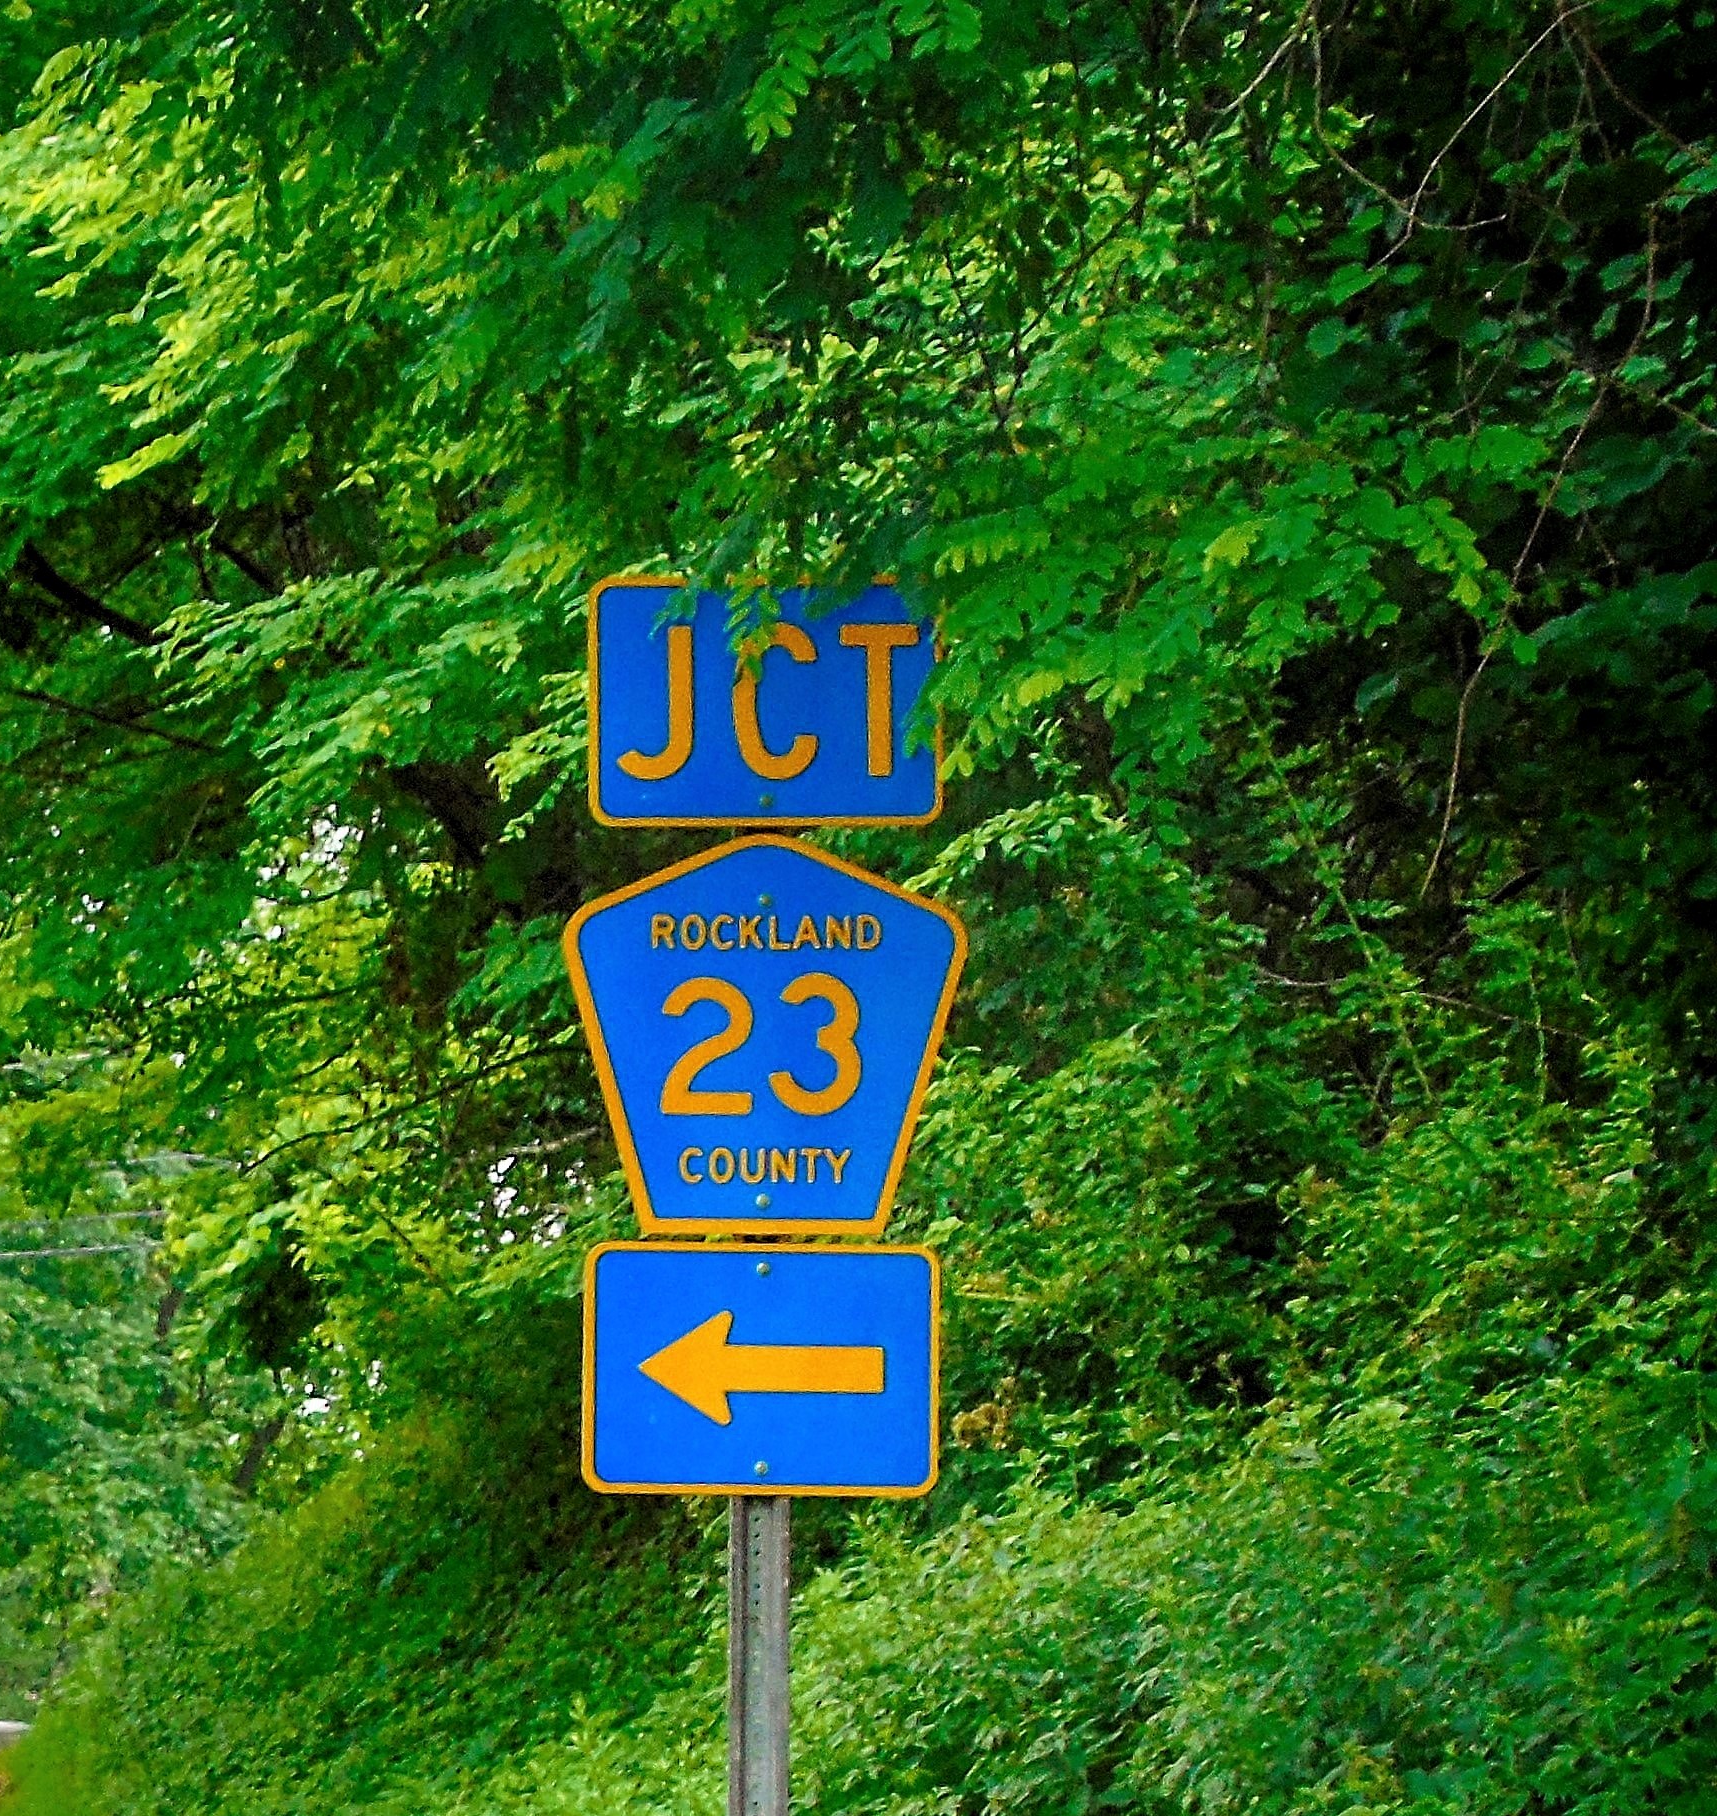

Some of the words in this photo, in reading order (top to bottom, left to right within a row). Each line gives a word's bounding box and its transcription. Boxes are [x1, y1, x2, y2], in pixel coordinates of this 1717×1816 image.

[616, 622, 920, 781] JCT
[650, 913, 882, 951] ROCKLAND
[659, 972, 863, 1117] 23
[678, 1147, 851, 1185] COUNTY
